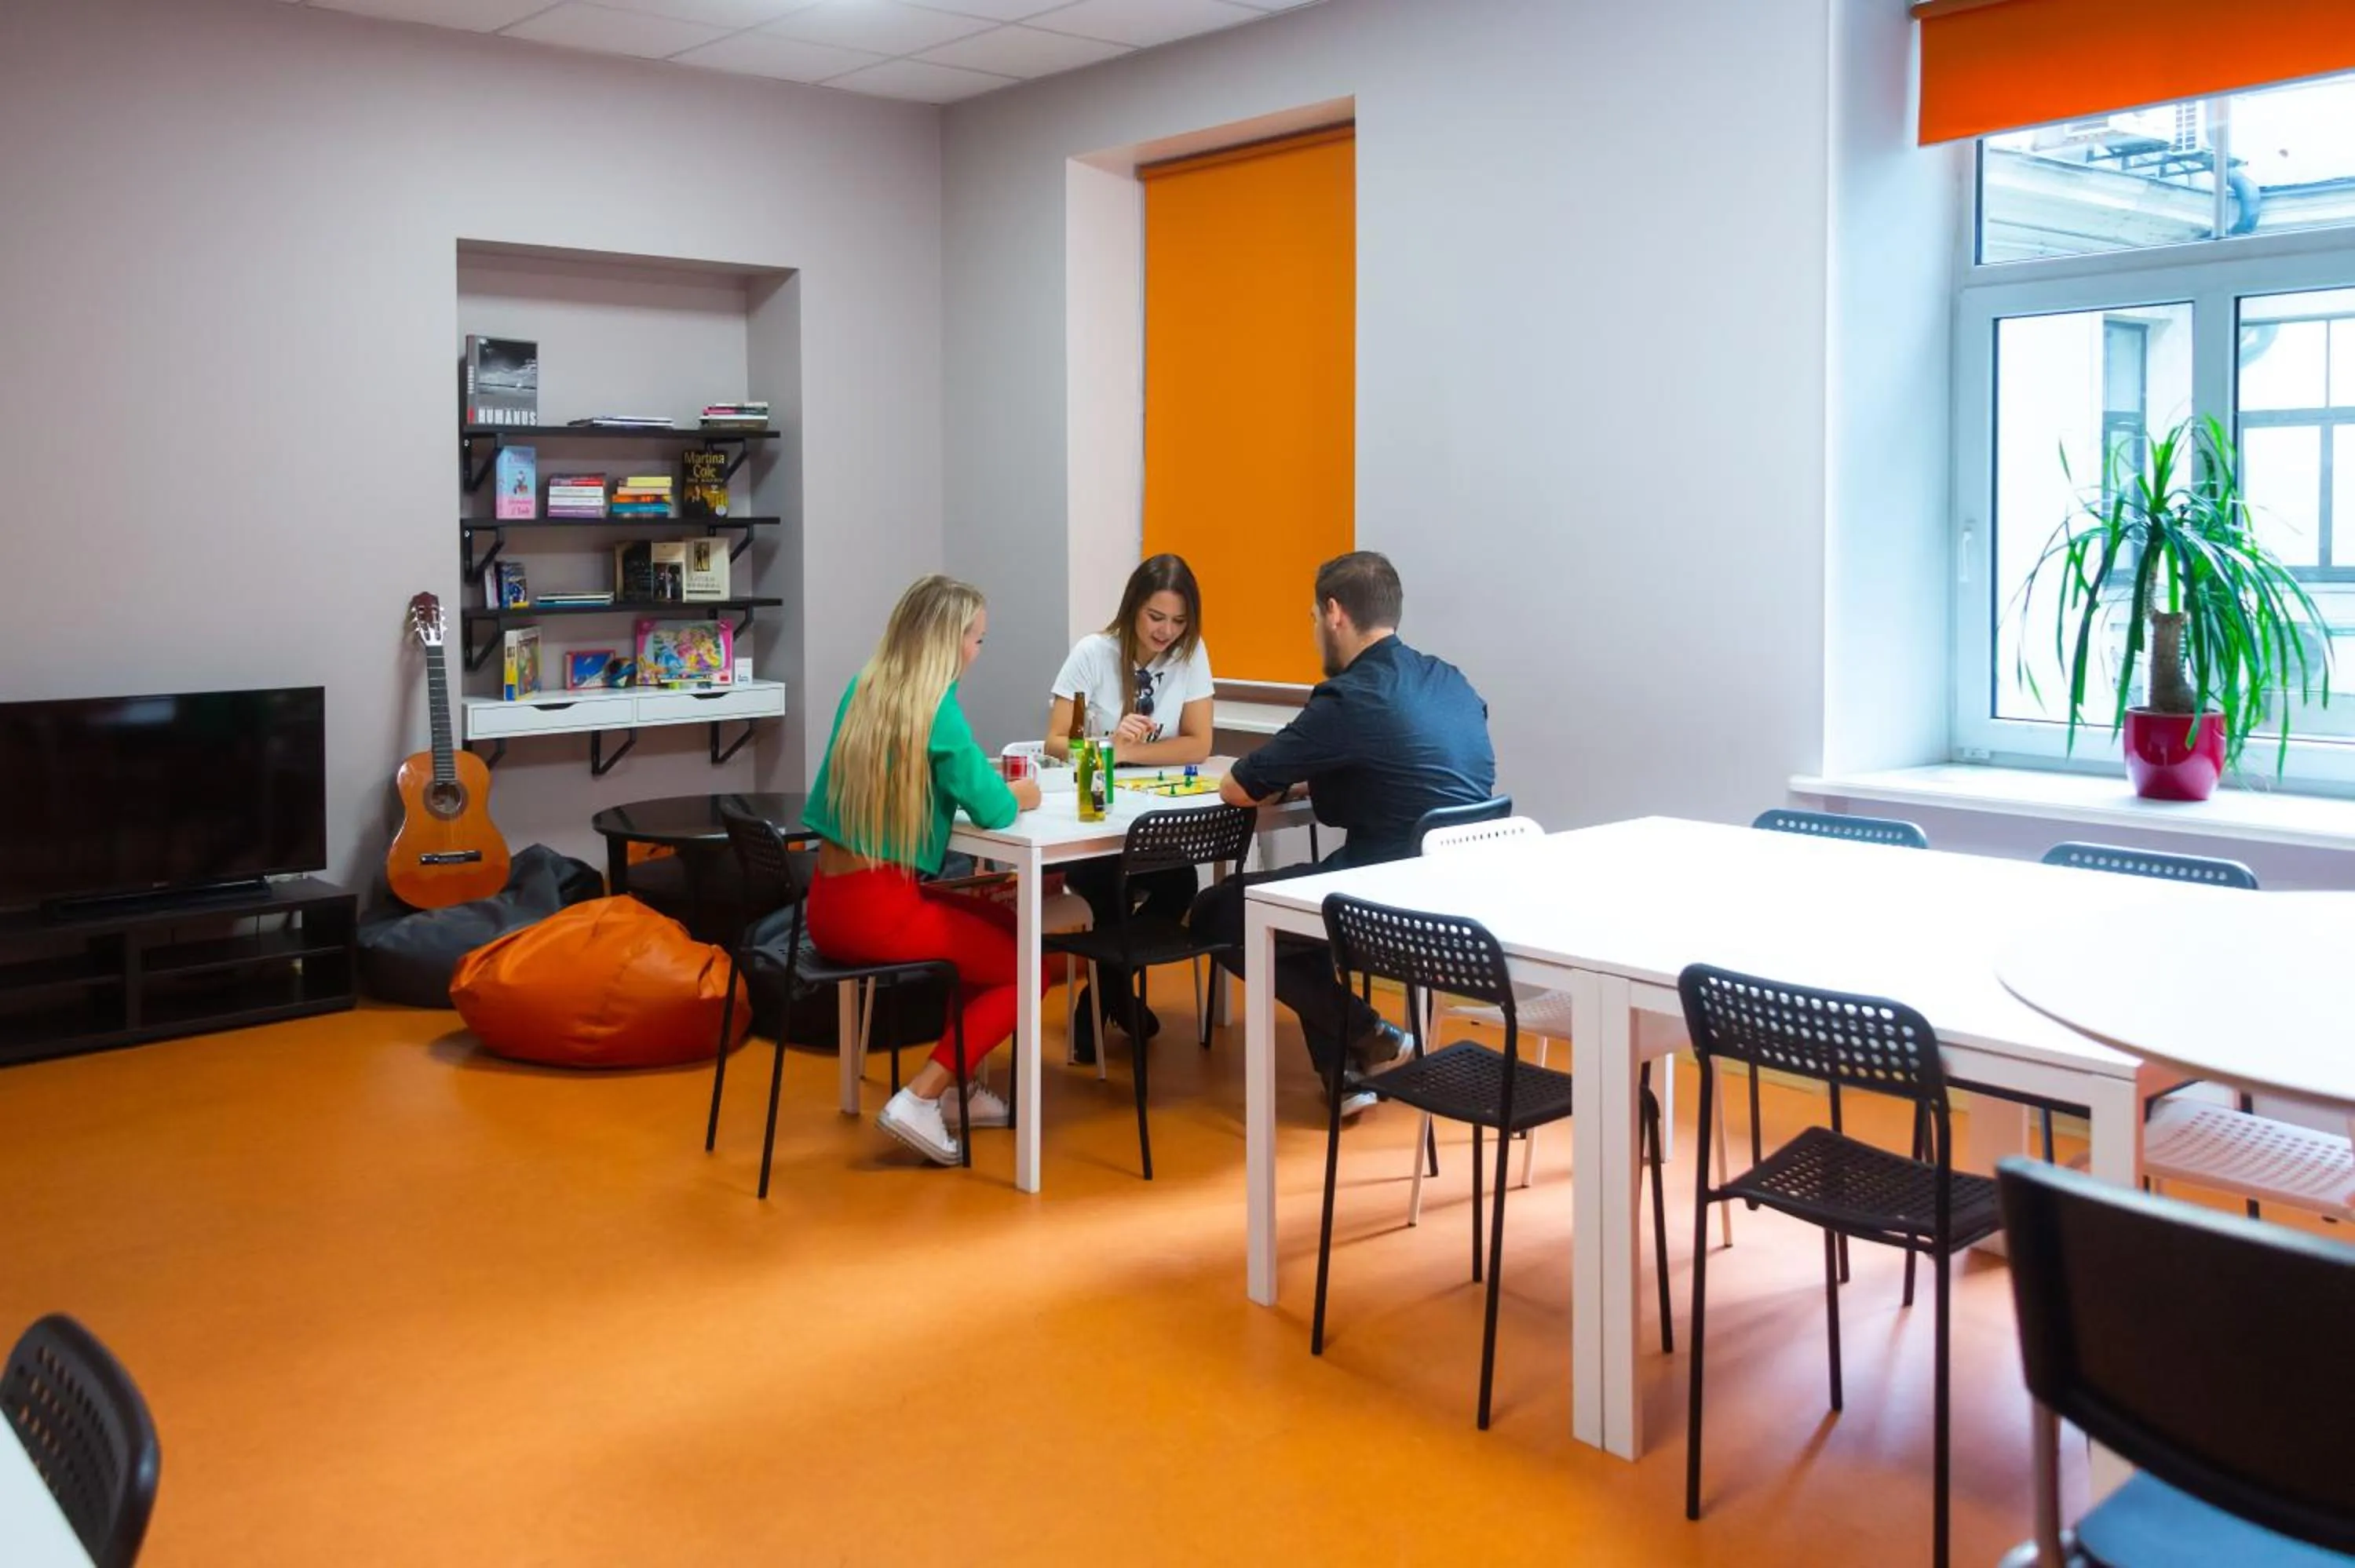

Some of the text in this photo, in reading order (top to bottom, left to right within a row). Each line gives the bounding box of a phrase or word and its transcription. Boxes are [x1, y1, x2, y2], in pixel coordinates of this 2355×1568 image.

[477, 407, 536, 426] HUMANUS
[684, 451, 725, 465] Martina
[692, 464, 717, 479] Cole
